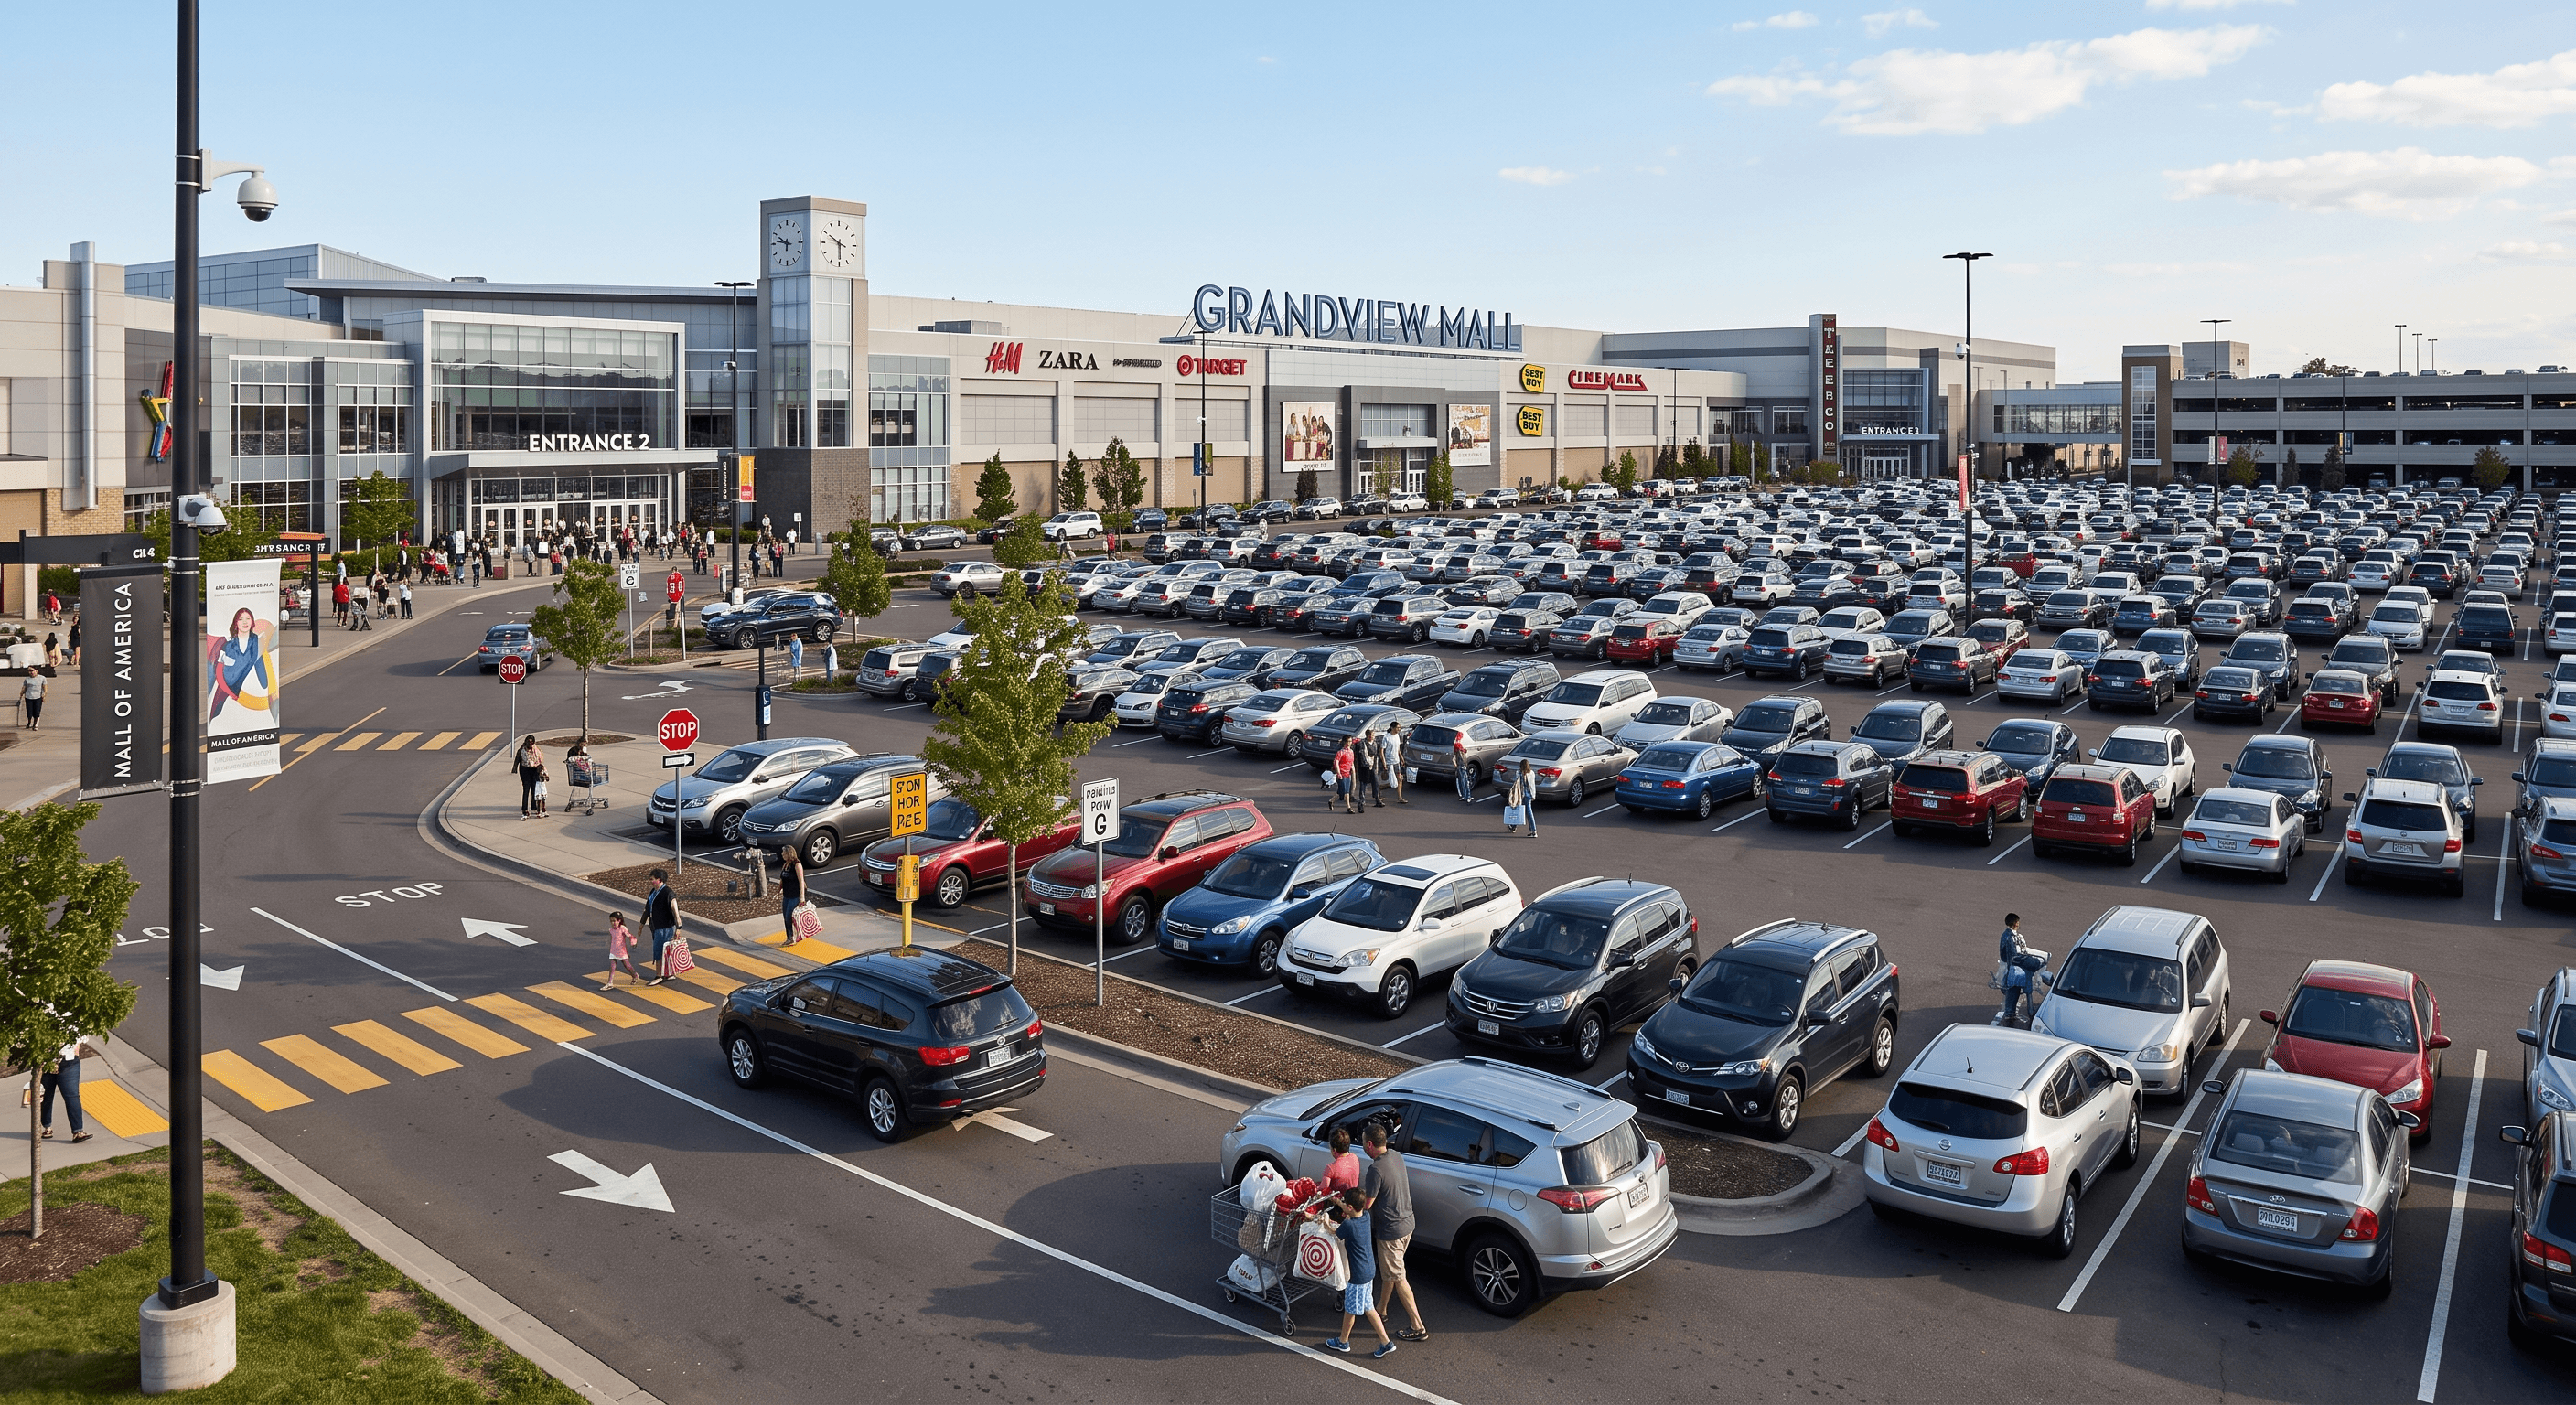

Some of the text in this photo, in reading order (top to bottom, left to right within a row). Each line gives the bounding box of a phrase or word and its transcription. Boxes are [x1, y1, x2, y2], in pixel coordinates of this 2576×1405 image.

[1194, 284, 1521, 351] GRANDVIEW MALL
[985, 341, 1023, 374] H&M
[1038, 350, 1100, 370] ZARA
[1194, 358, 1247, 376] TARGET
[1568, 370, 1648, 391] CINEMARK
[1522, 411, 1542, 422] BEST
[1522, 421, 1540, 431] BUY
[1862, 426, 1913, 434] ENTRANCE
[529, 434, 649, 451] ENTRANCE 2
[500, 663, 524, 675] STOP
[114, 582, 132, 778] MALL OF AMERICA
[660, 721, 697, 740] STOP
[211, 738, 231, 748] MALL
[242, 733, 275, 744] AMERICA
[897, 796, 920, 810] HOR
[1094, 813, 1107, 836] G
[335, 882, 443, 907] STOP
